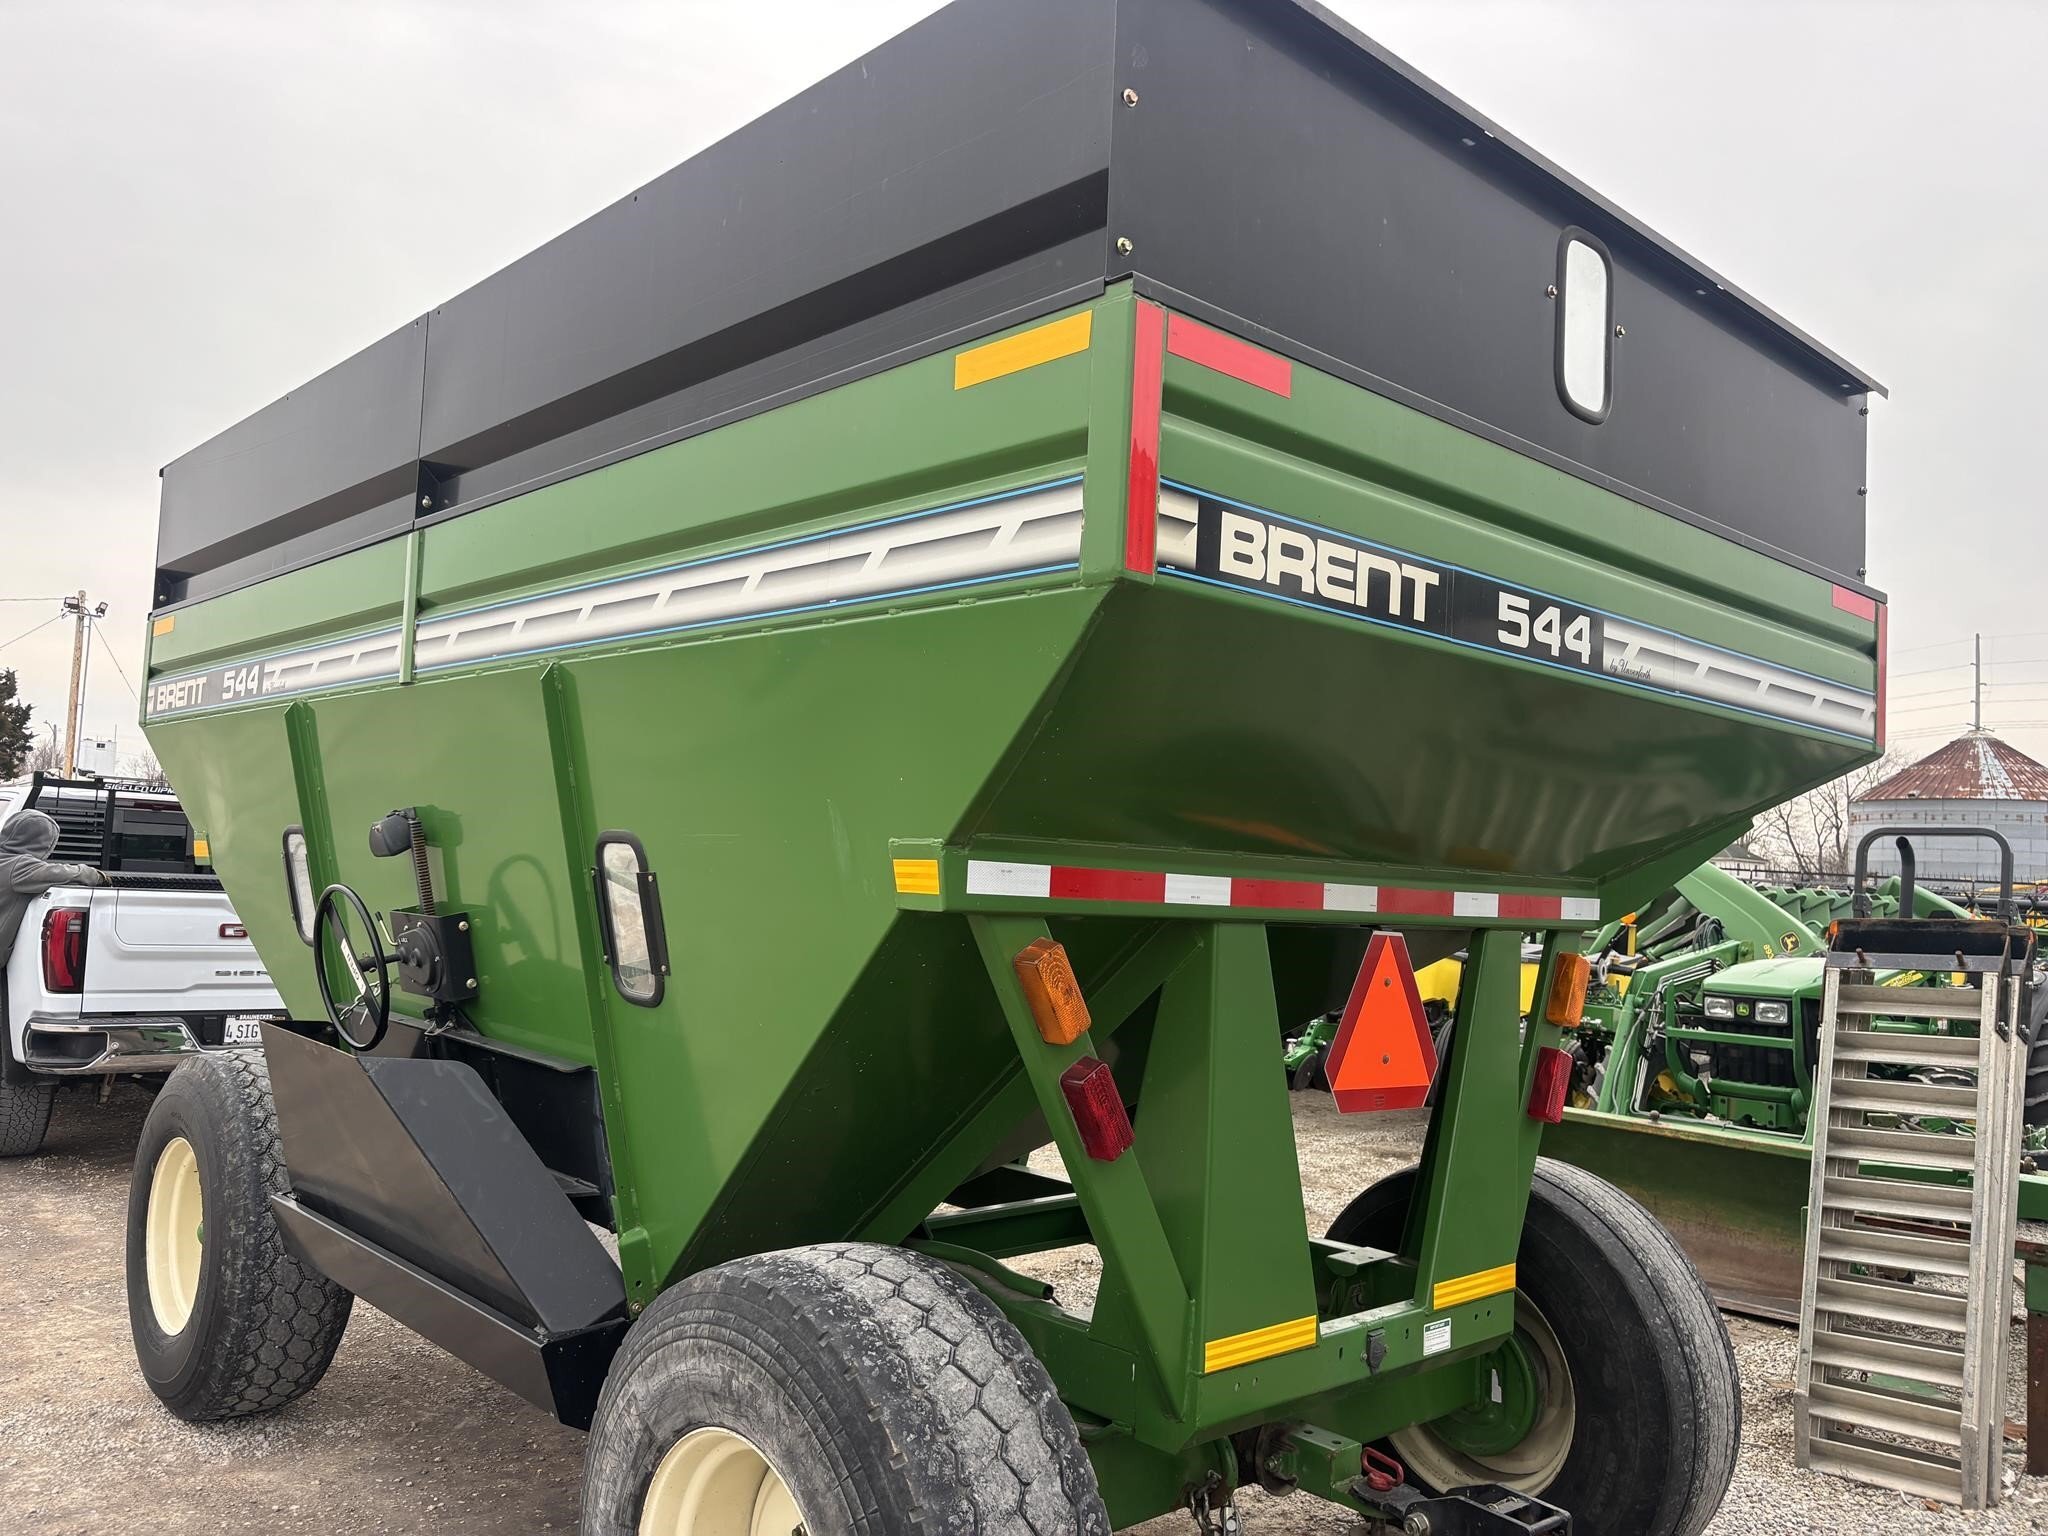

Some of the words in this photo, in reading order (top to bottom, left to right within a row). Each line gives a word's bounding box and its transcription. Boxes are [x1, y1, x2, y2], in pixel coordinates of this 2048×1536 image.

[1217, 510, 1440, 624] BRENT
[1496, 590, 1593, 664] 544
[157, 676, 207, 711] BRENT
[222, 665, 259, 700] 544
[226, 1024, 233, 1039] 4
